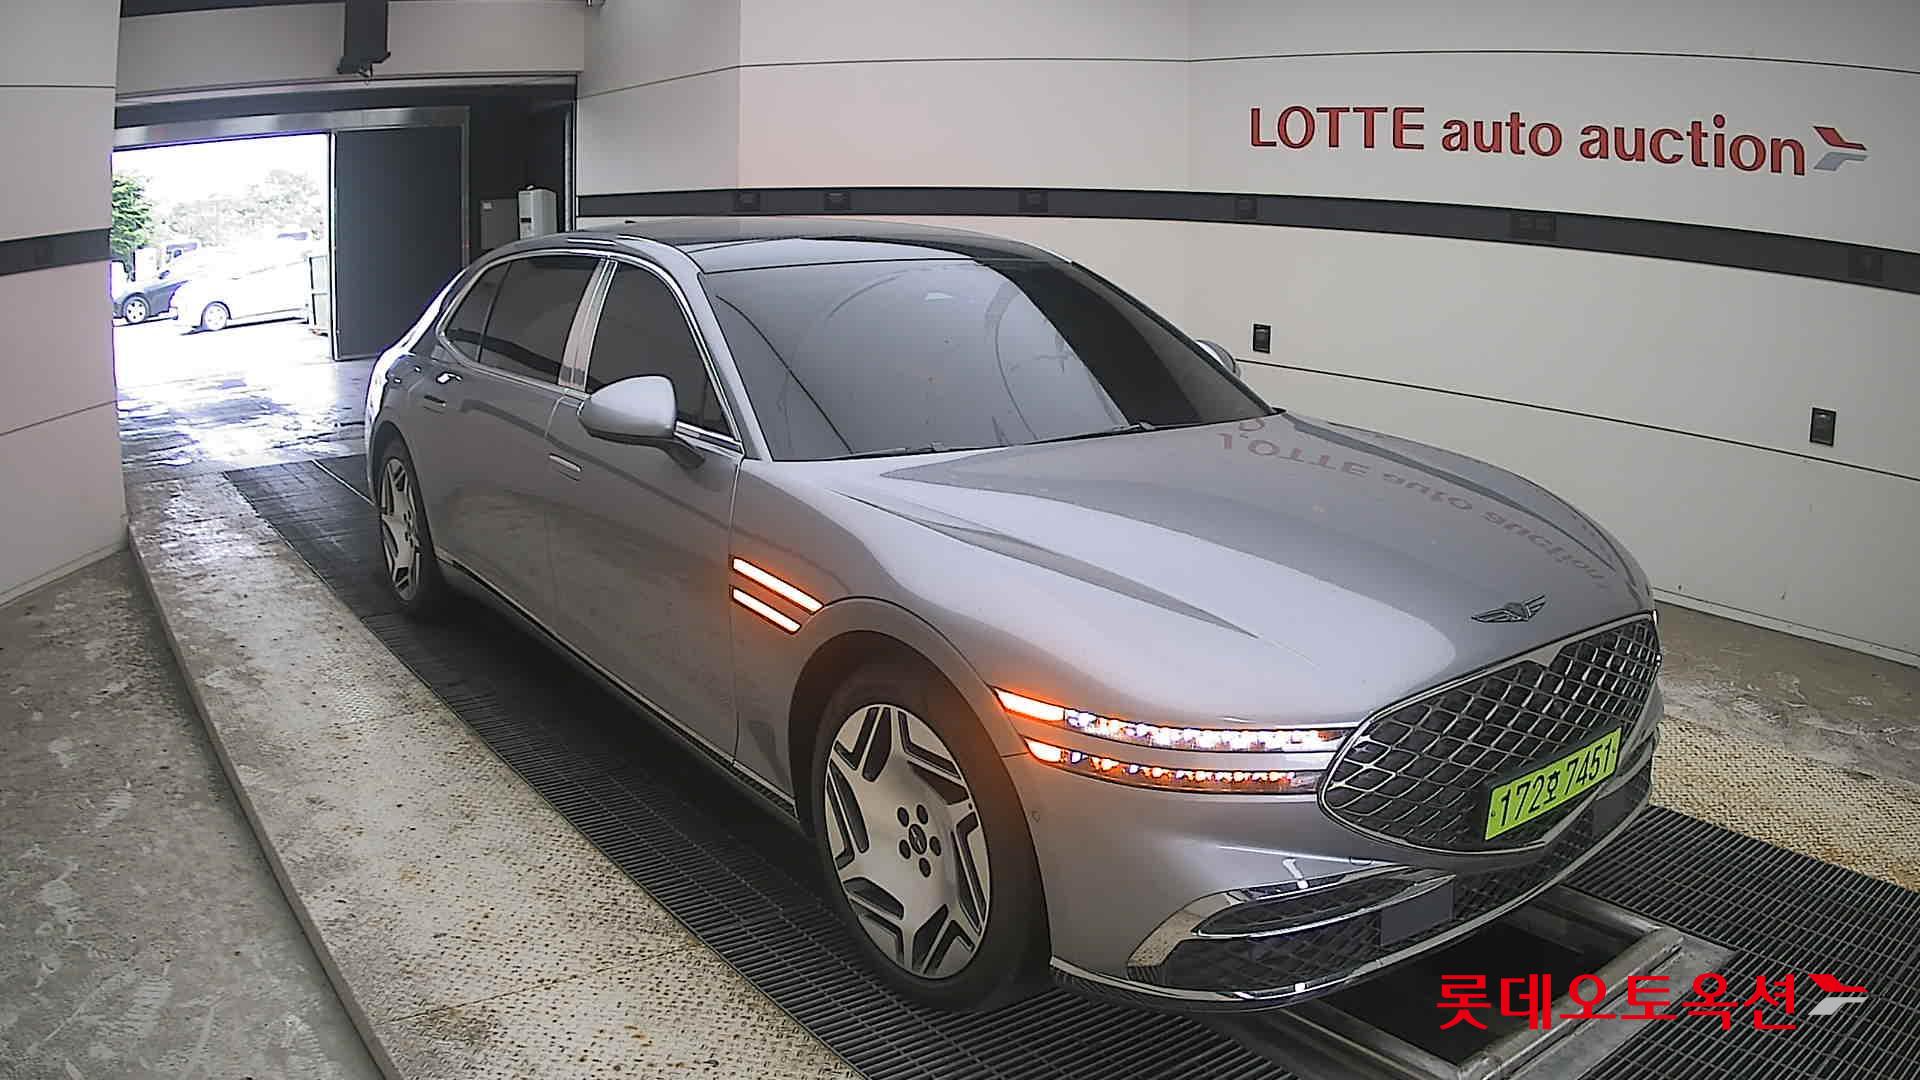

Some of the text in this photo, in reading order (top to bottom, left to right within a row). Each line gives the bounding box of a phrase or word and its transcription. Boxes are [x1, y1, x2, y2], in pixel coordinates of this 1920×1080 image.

[1249, 106, 1806, 176] LOTTE auto auction
[1500, 737, 1613, 827] 172호 7451
